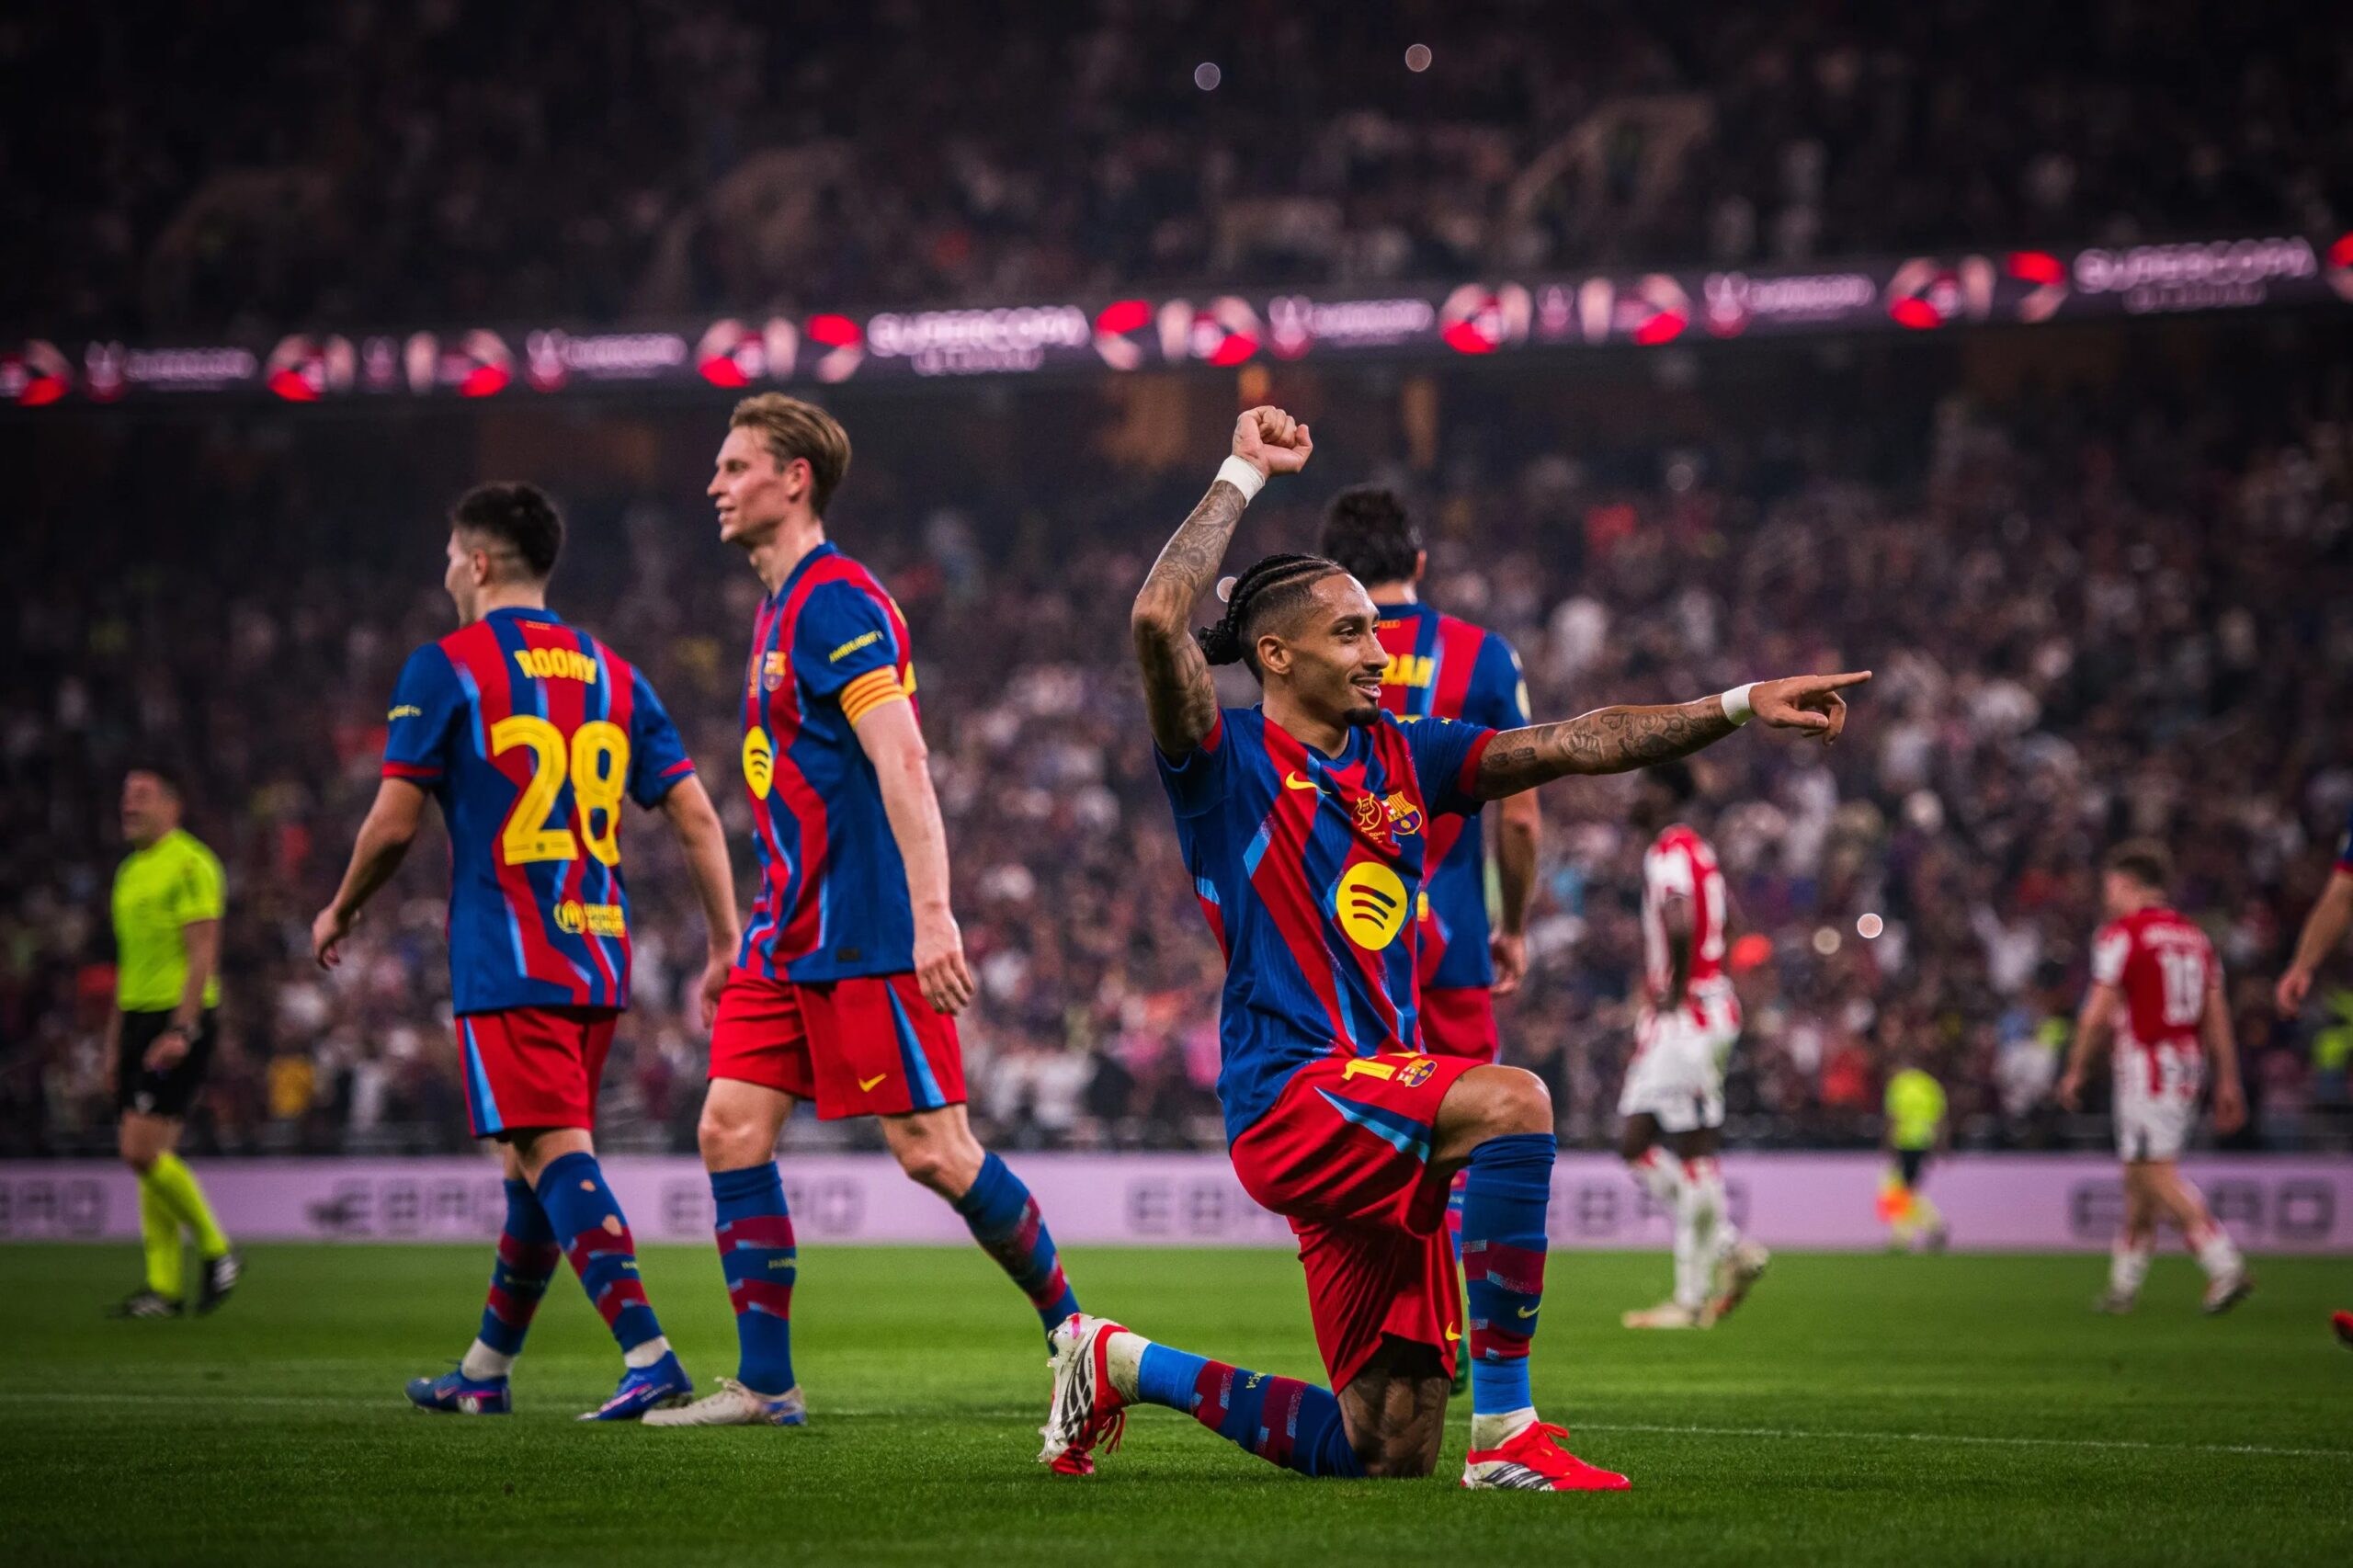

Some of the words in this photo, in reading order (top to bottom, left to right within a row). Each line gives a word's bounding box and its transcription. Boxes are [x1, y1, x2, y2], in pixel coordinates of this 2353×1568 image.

[1379, 653, 1436, 688] RAN
[491, 714, 631, 867] 28
[662, 1178, 867, 1236] EO
